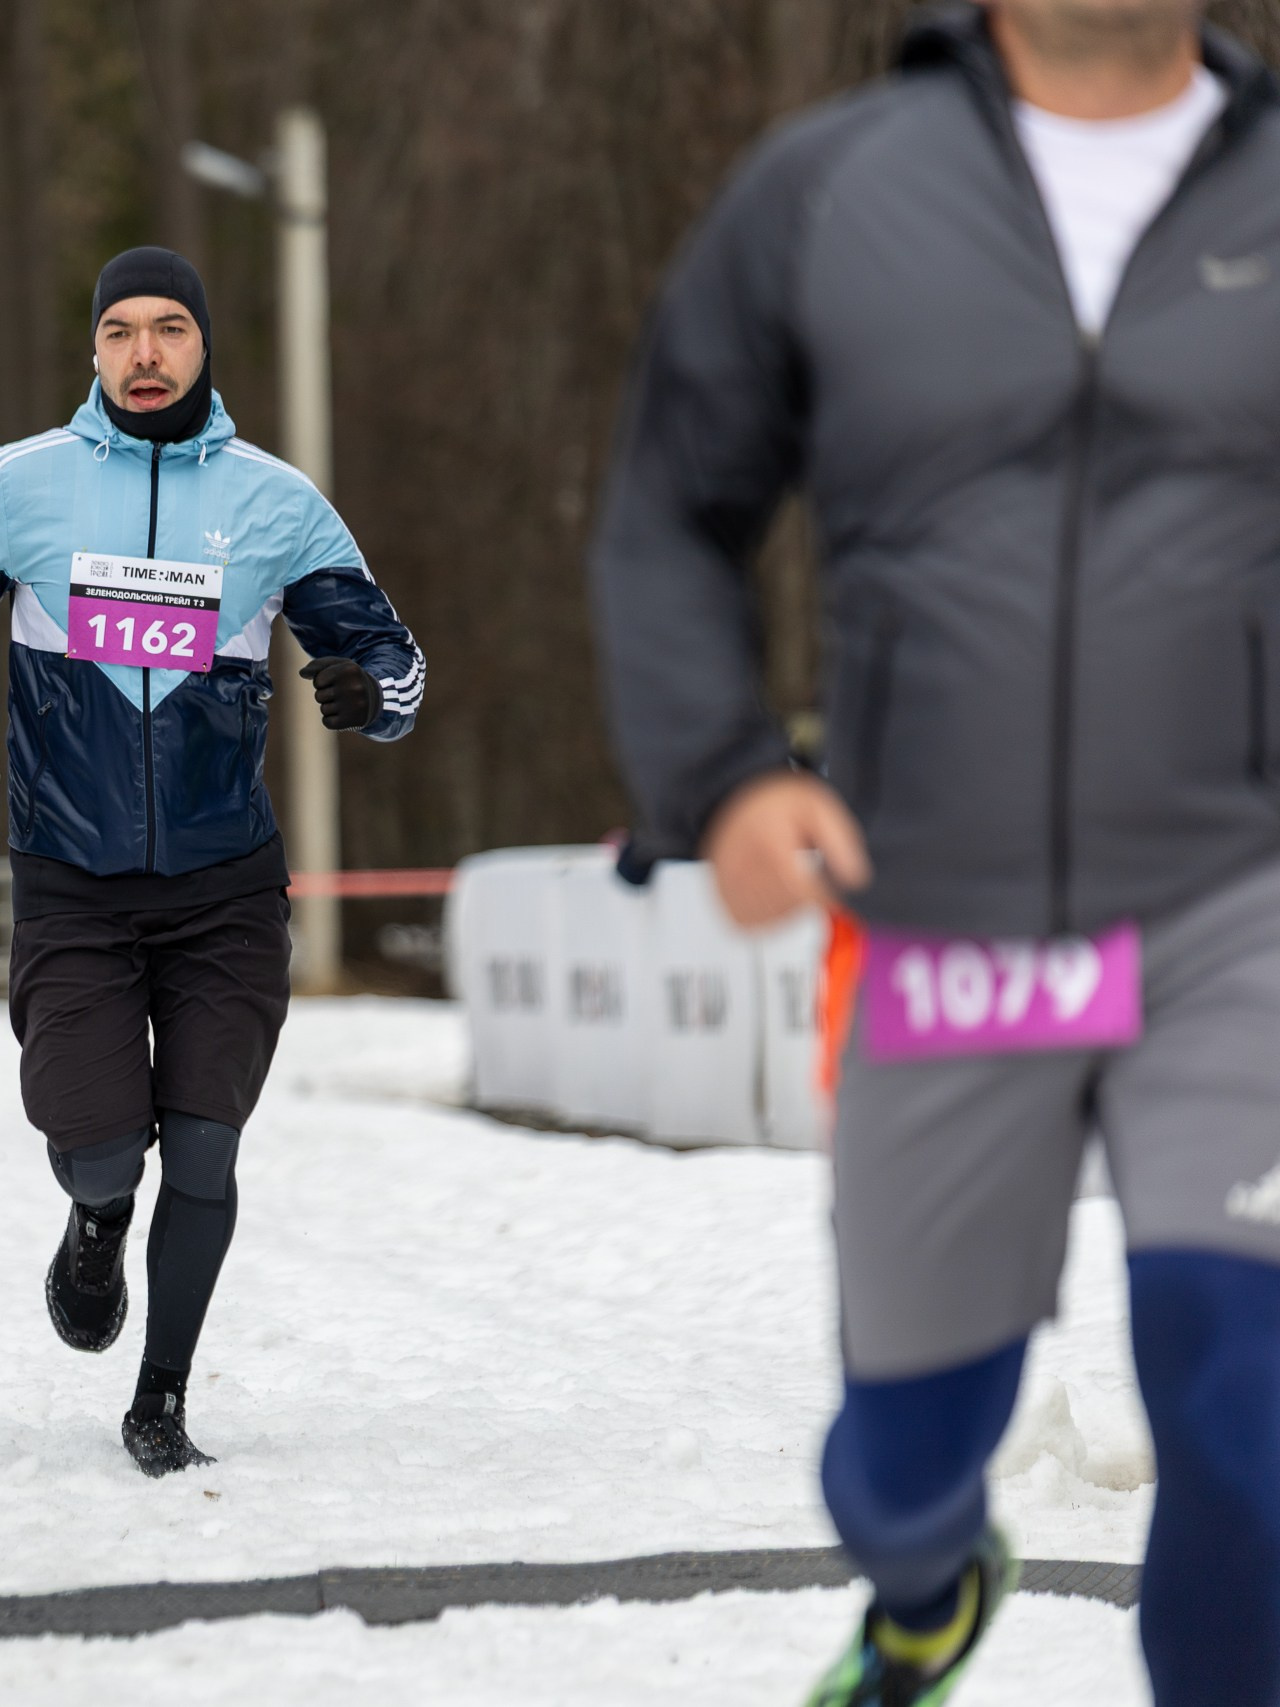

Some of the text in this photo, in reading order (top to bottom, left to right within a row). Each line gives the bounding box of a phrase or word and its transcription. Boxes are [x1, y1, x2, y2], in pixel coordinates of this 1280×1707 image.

[85, 587, 163, 603] ЗЕЛЕНОДОЛЬСКИЙ
[164, 595, 191, 606] ТРЕЙЛ
[88, 613, 196, 658] 1162
[892, 938, 1104, 1036] 1079
